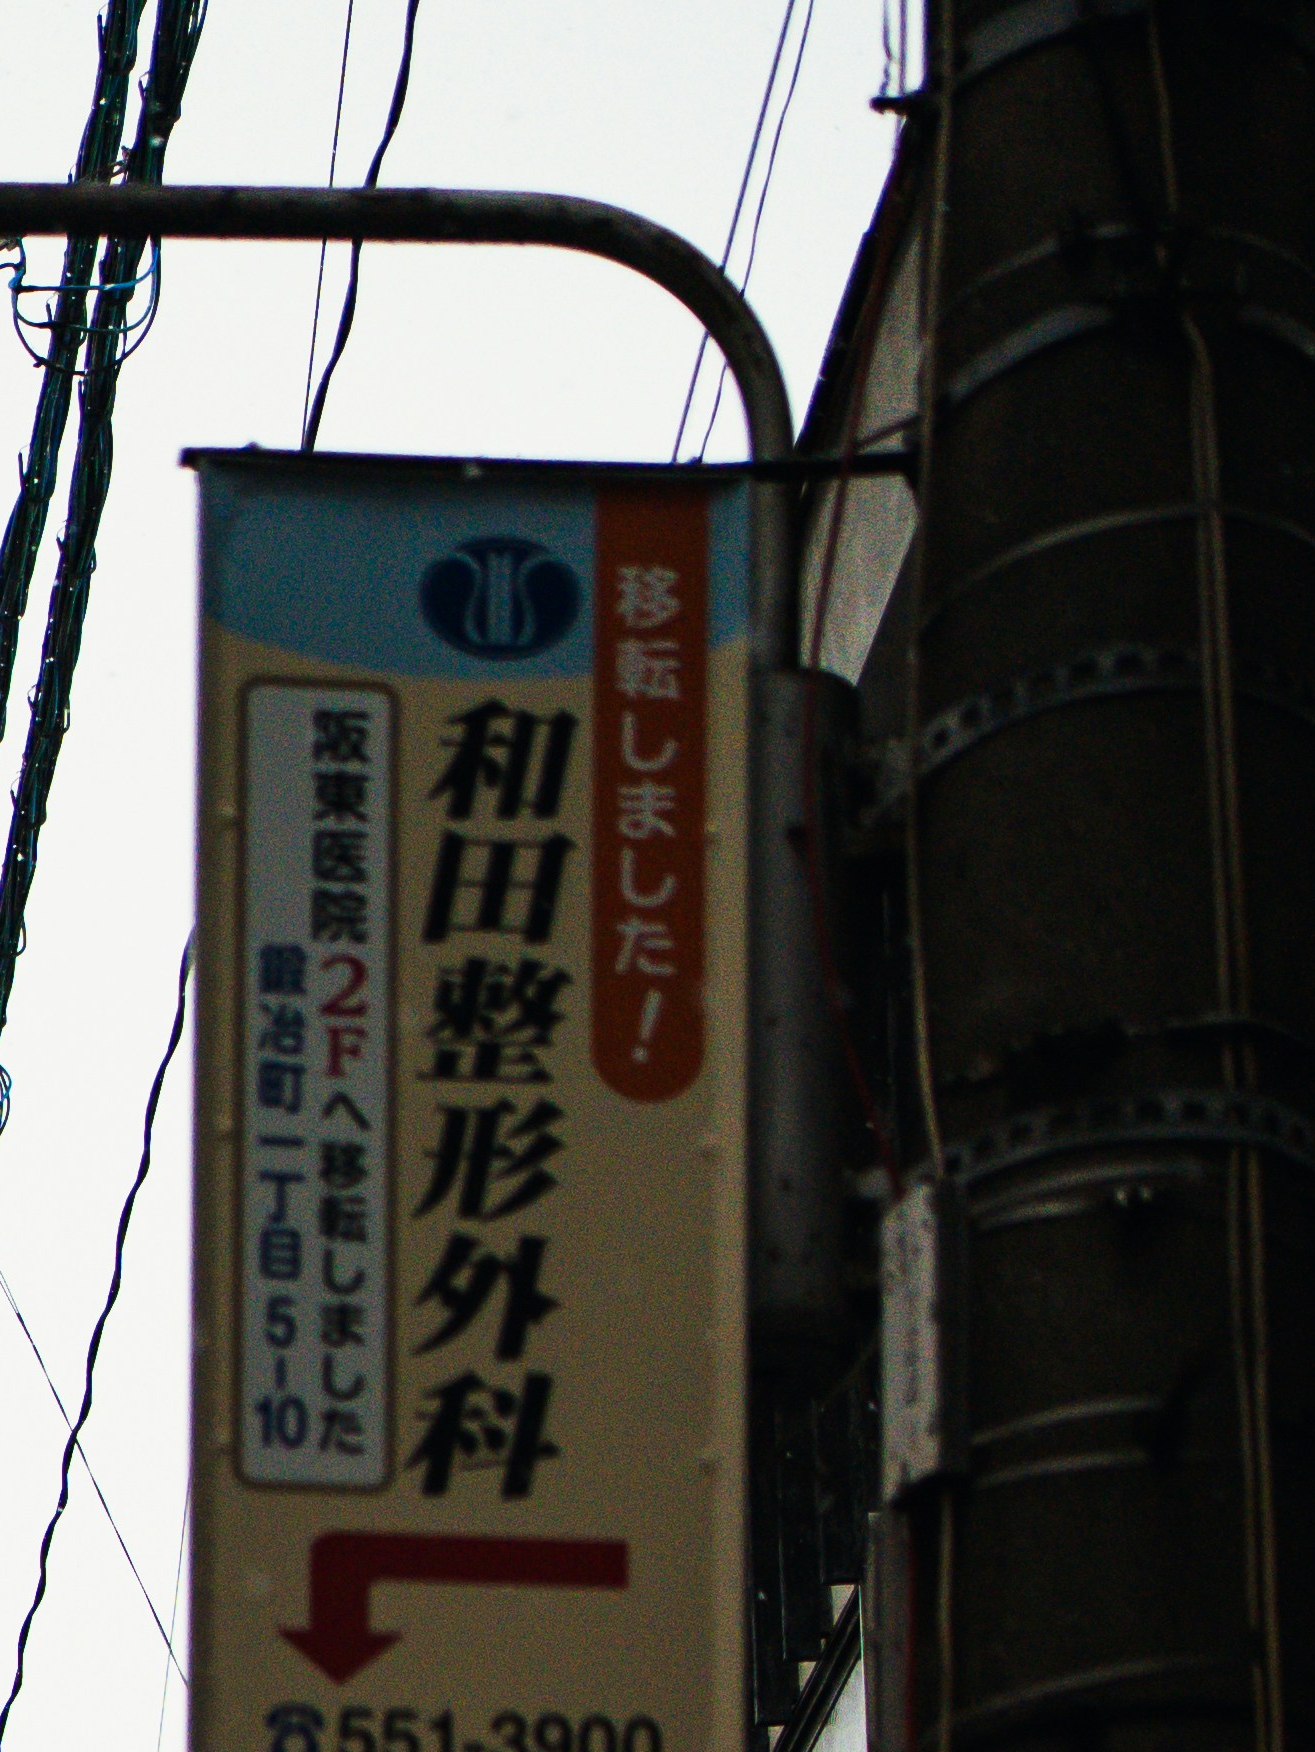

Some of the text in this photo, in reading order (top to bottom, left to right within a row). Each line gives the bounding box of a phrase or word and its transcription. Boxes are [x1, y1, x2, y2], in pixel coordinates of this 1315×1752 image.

[404, 696, 581, 1500] 和田整形外科
